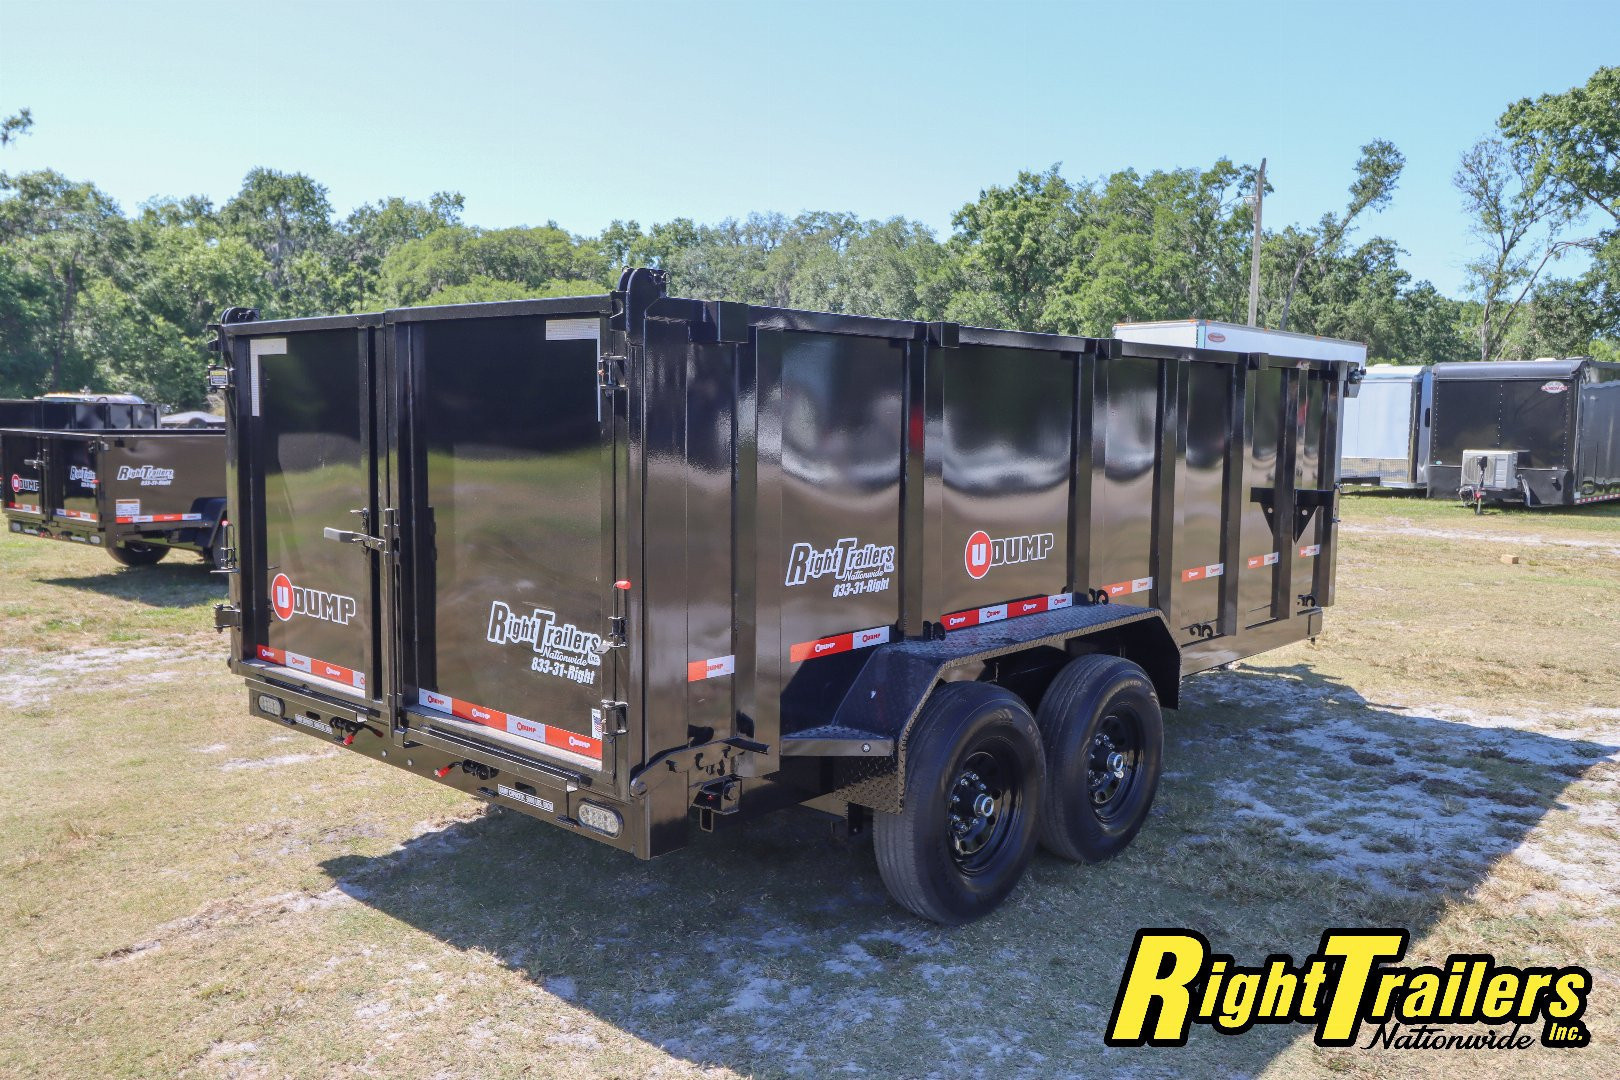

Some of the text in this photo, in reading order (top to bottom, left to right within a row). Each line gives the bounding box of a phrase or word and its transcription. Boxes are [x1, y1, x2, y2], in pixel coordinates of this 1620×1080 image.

[842, 567, 885, 582] Nationwide
[832, 577, 890, 598] 833-31-Right
[540, 646, 588, 667] Nationwide
[531, 656, 595, 685] 833-31-Right
